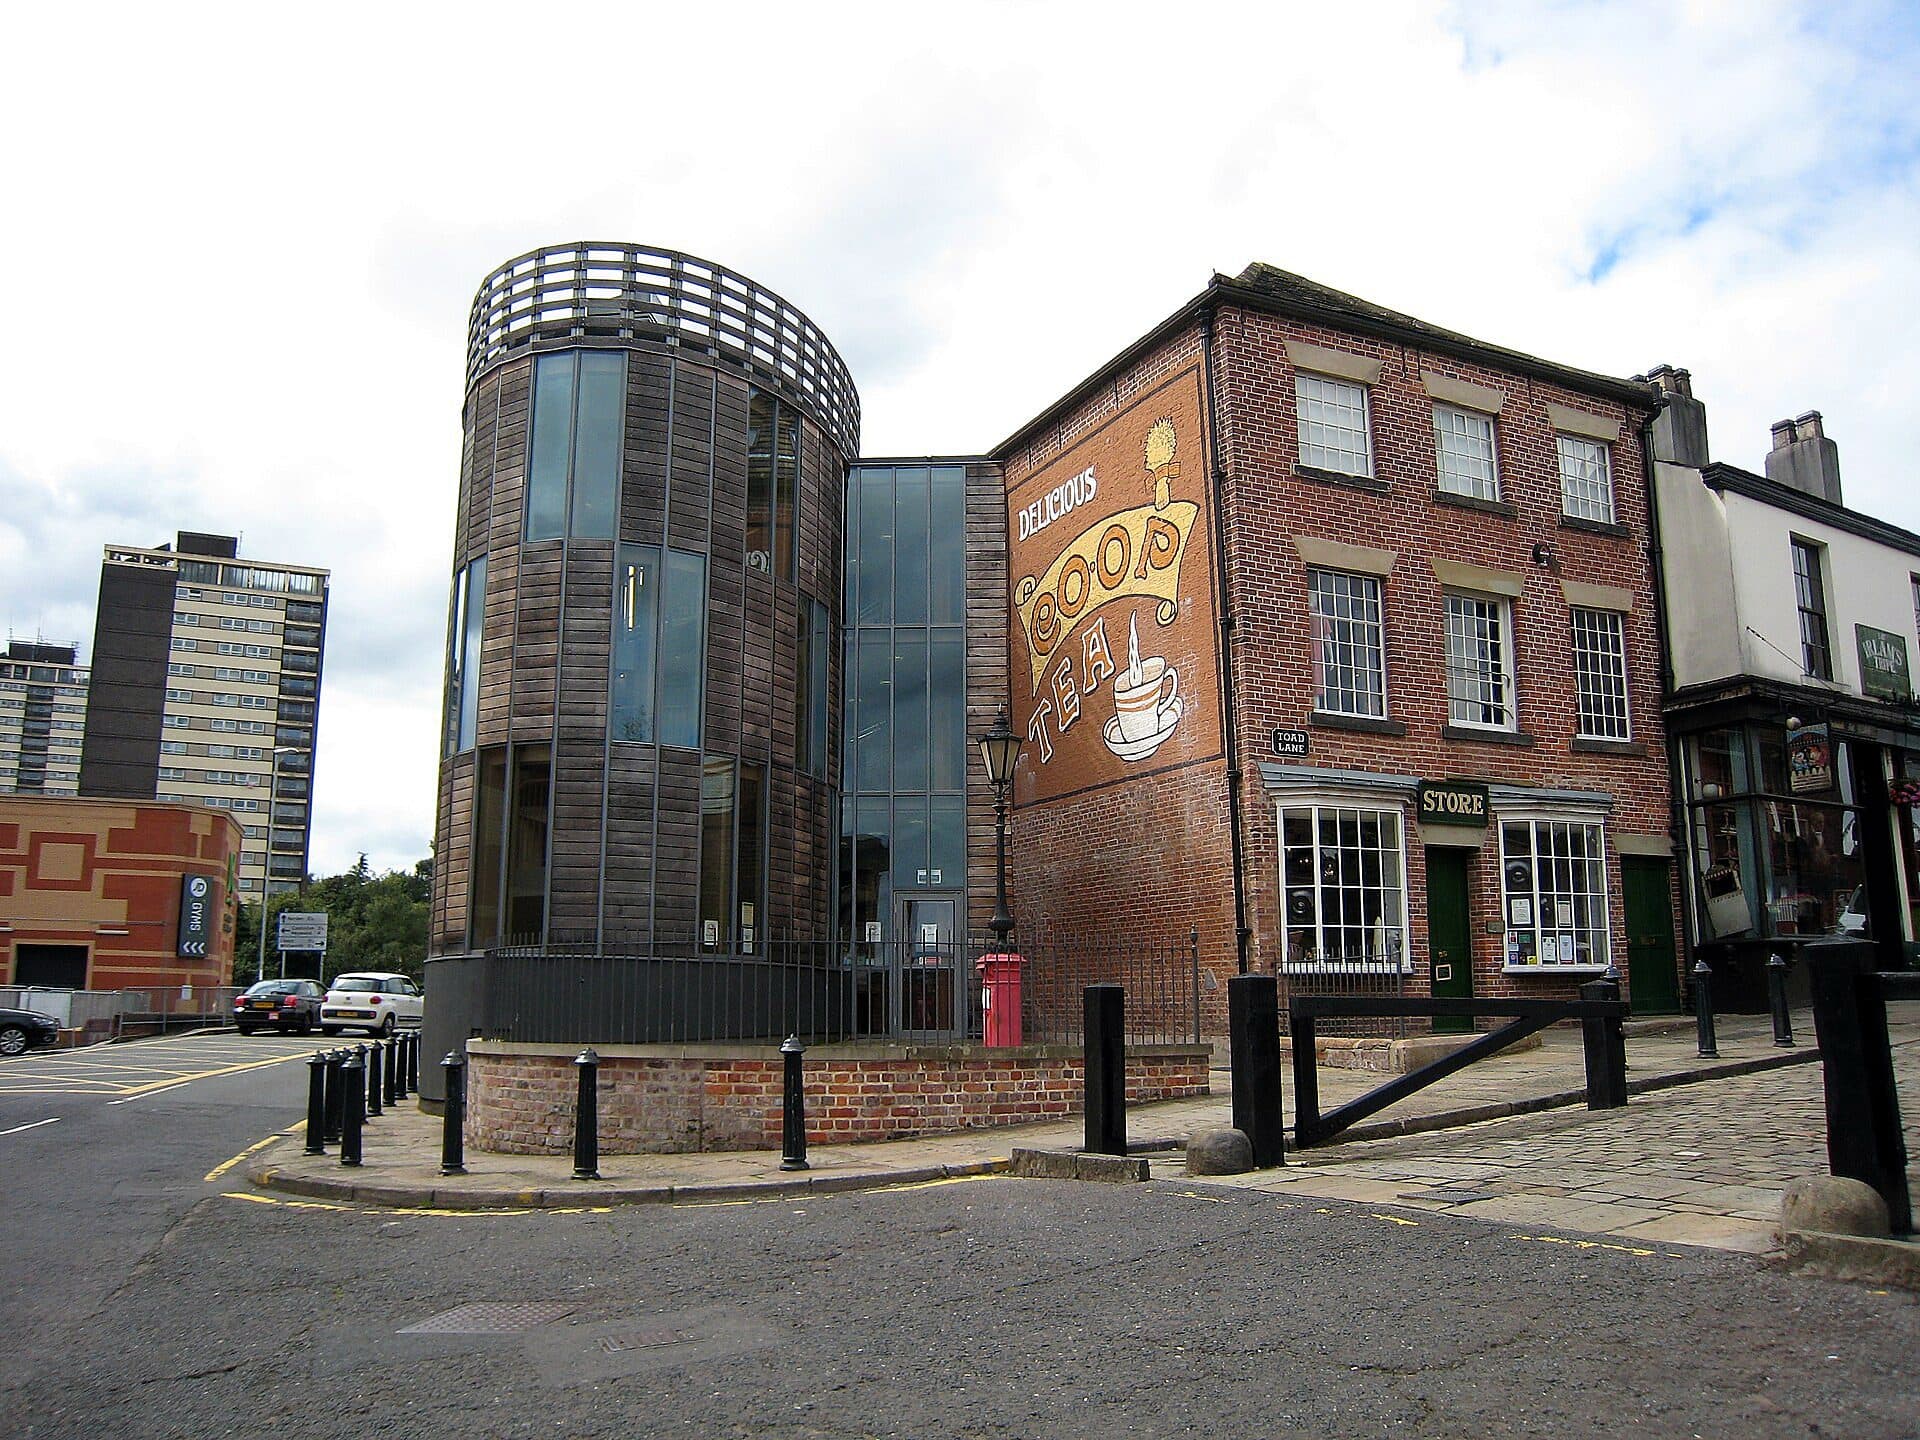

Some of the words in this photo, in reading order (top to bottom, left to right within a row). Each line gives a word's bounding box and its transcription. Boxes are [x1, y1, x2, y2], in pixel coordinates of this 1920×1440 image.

[1017, 464, 1098, 542] DELICIOUS
[1028, 616, 1116, 765] TEA
[1277, 731, 1305, 743] TOAD
[1278, 742, 1305, 754] LANE
[1423, 790, 1484, 815] STORE
[189, 902, 203, 931] GYMS
